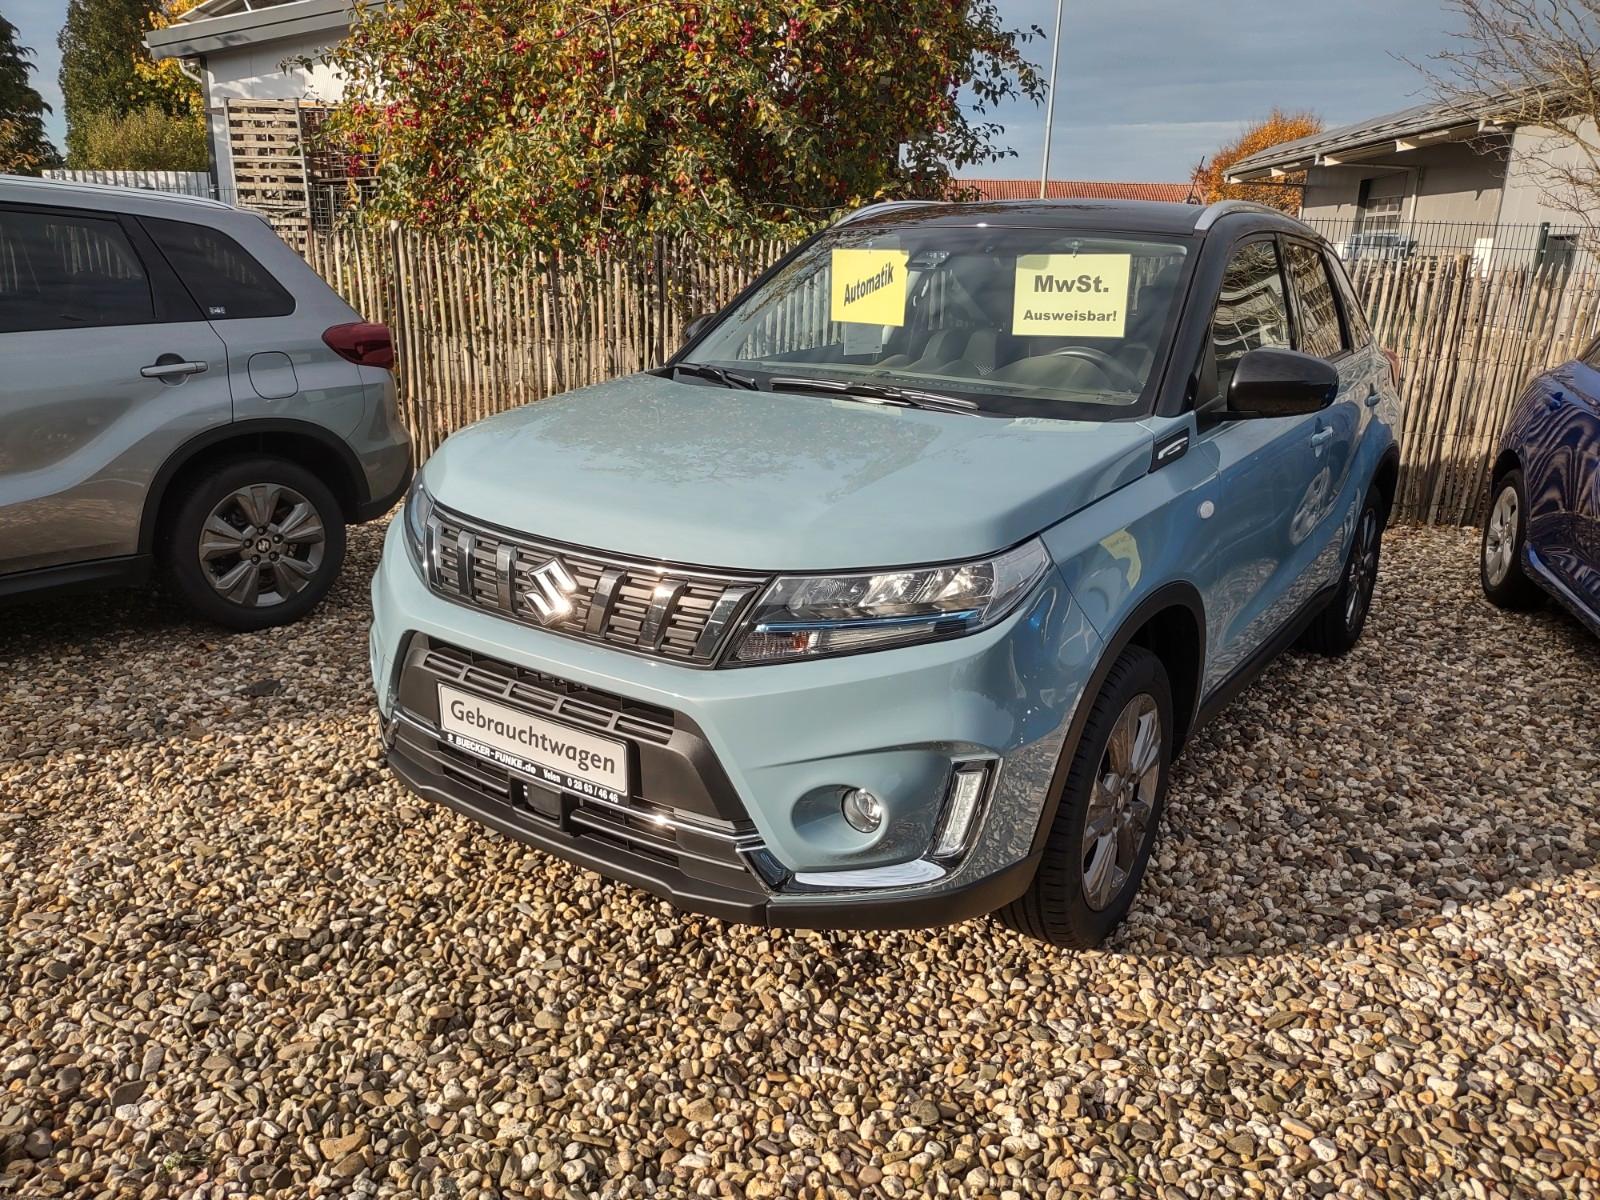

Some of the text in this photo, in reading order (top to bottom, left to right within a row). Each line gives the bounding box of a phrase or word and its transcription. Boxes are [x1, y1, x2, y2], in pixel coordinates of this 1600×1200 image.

[843, 261, 894, 306] Automatik
[1034, 274, 1109, 293] MwSt.
[1023, 309, 1117, 323] Ausweisbar!
[450, 699, 615, 774] Gebrauchtwagen
[543, 768, 561, 783] Velen
